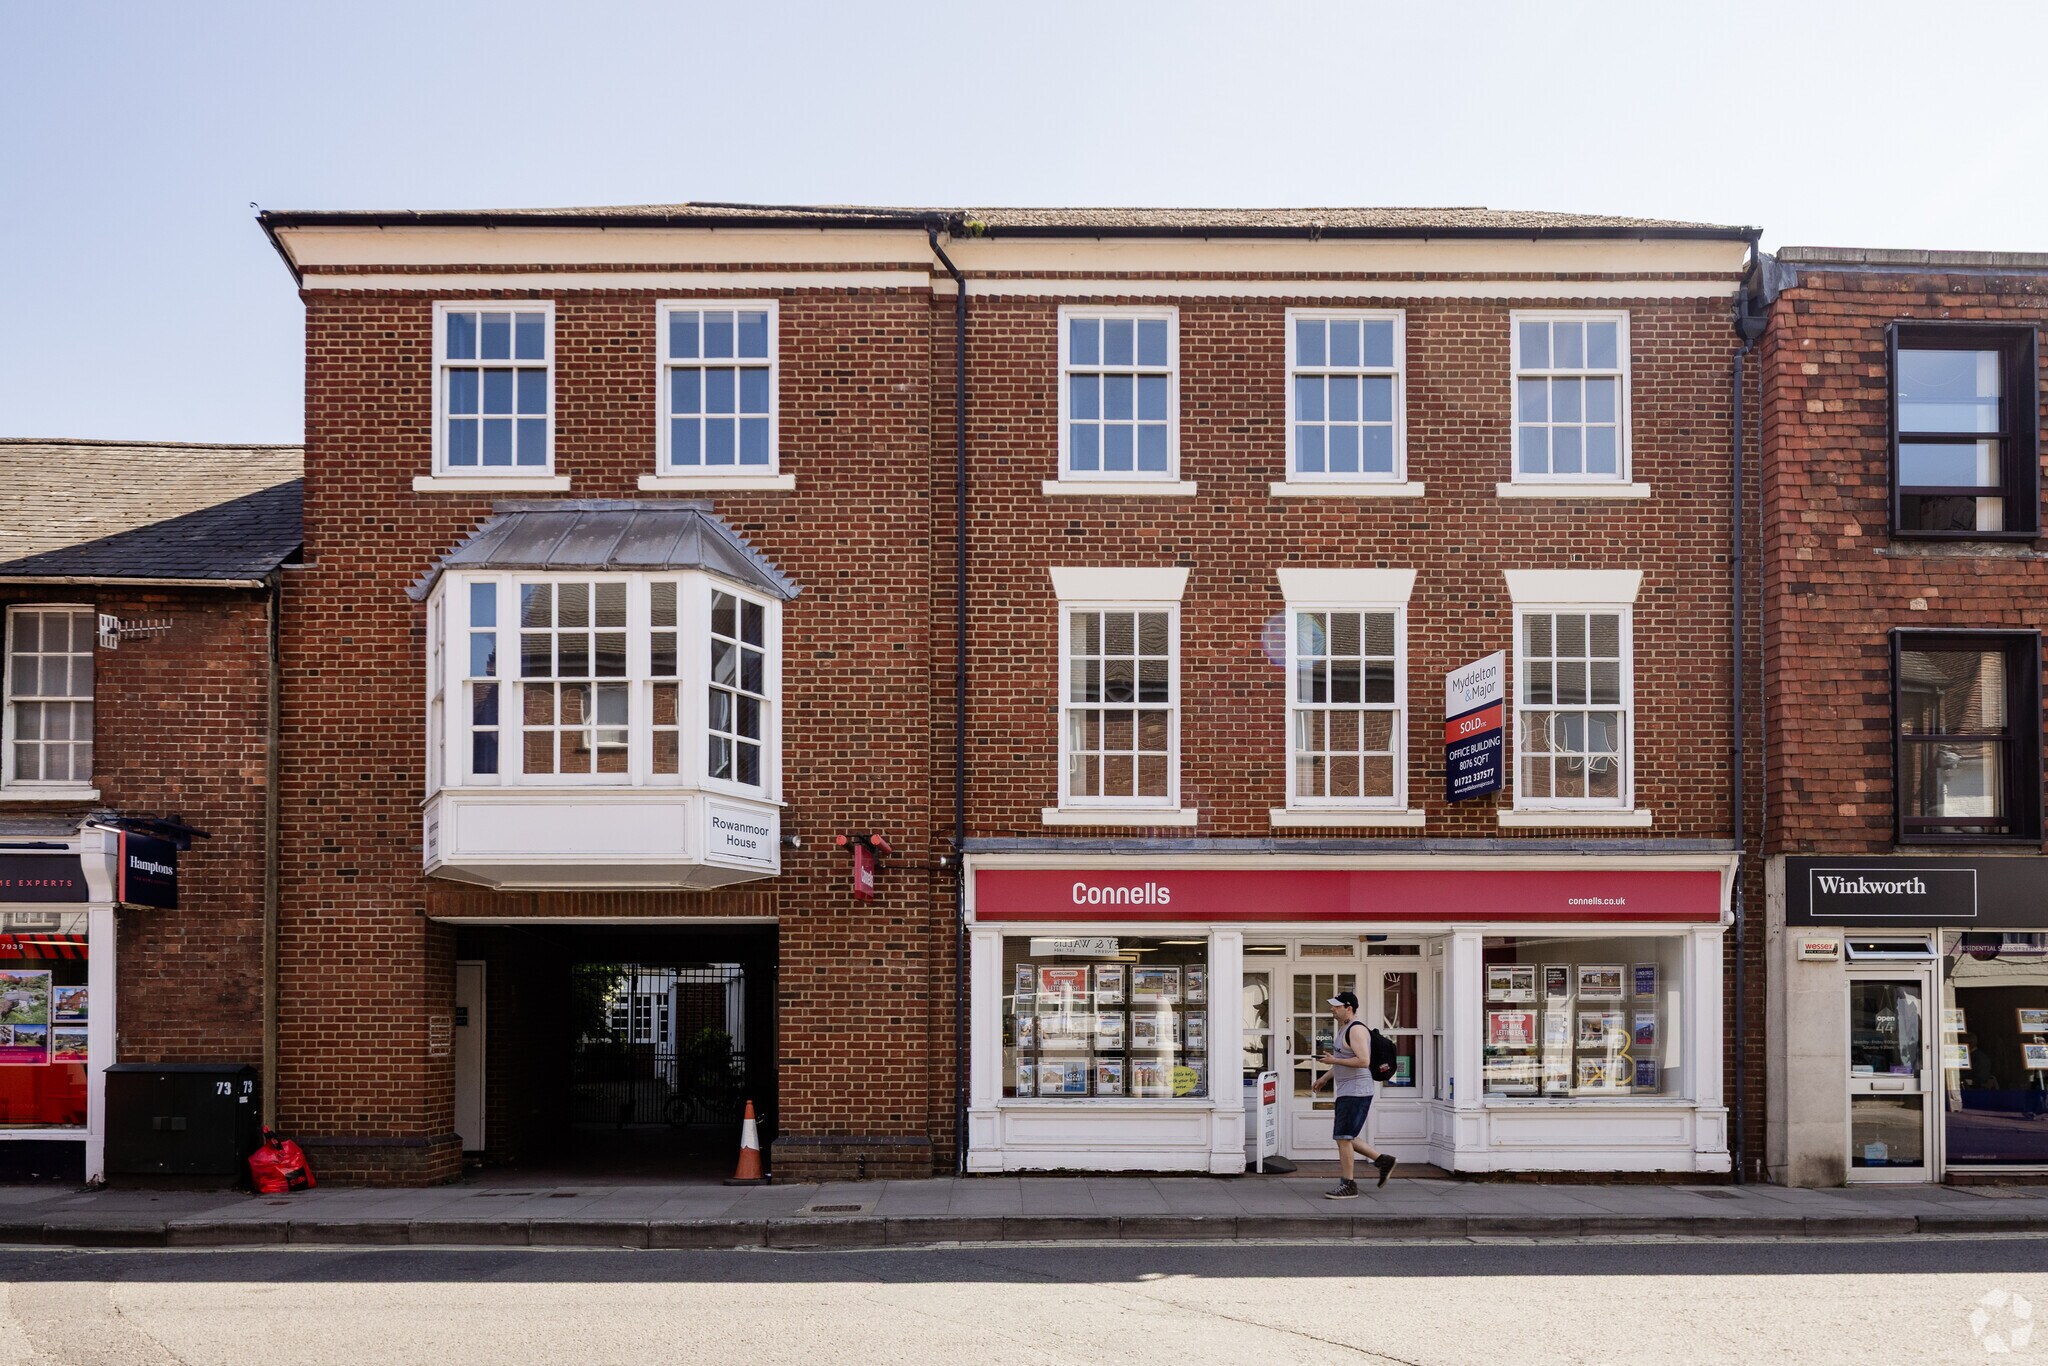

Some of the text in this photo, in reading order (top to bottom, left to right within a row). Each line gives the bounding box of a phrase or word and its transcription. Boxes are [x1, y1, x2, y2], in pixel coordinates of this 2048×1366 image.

[1452, 665, 1497, 693] Myddelton
[1460, 717, 1481, 735] SOLD
[1449, 736, 1501, 761] OFFICE BUILDING
[1459, 753, 1490, 771] 8076 SQFT
[1454, 768, 1495, 787] 01722 337577
[712, 816, 769, 837] Rowanmoor
[726, 834, 757, 849] House
[130, 855, 173, 875] Hamptons
[1072, 882, 1171, 905] Connells
[1817, 876, 1927, 895] Winkworth
[1568, 897, 1626, 905] connells.co.uk
[216, 1082, 232, 1095] 73
[243, 1080, 253, 1093] 73
